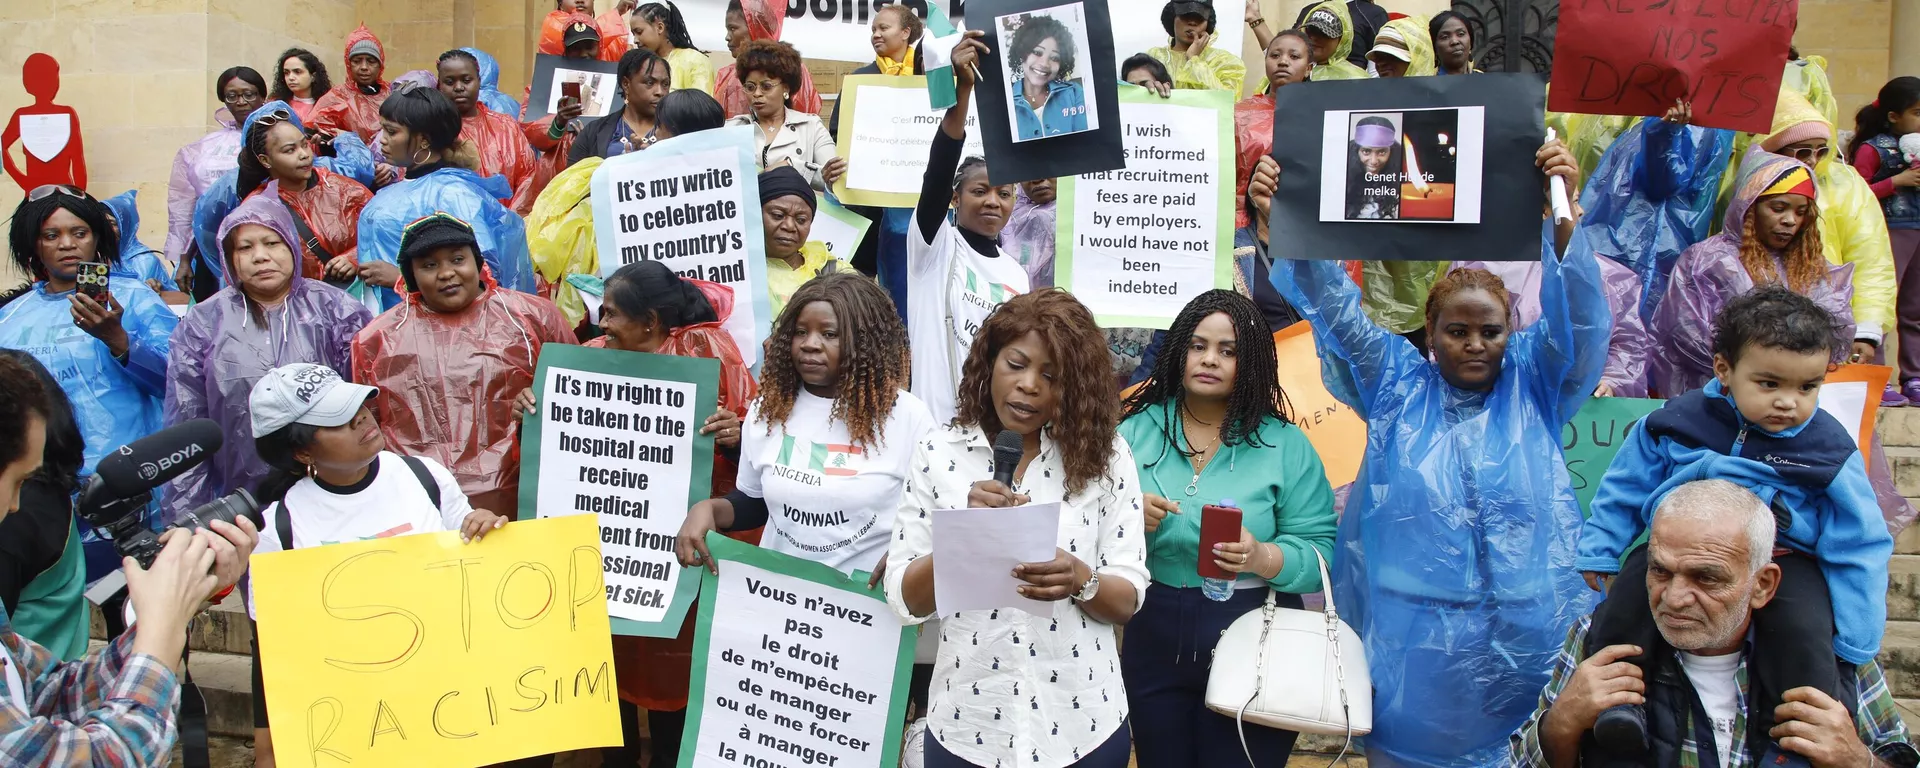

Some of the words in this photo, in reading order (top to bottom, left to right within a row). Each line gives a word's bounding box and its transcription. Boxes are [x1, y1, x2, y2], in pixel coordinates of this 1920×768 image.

[1649, 25, 1719, 61] NOS
[1576, 55, 1768, 118] DROITS
[913, 115, 942, 125] mon
[1126, 123, 1131, 136] I
[1135, 124, 1171, 138] wish
[1134, 145, 1205, 162] informed
[617, 180, 646, 203] It's
[650, 177, 678, 198] my
[682, 168, 733, 193] write
[1117, 169, 1209, 184] recruitment
[1364, 171, 1396, 182] Genet
[1399, 171, 1434, 182] Hude
[1096, 189, 1128, 204] fees
[1132, 193, 1158, 205] are
[1162, 192, 1196, 208] paid
[619, 213, 639, 233] to
[643, 200, 737, 230] celebrate
[1093, 211, 1111, 228] by
[1116, 213, 1201, 230] employers.
[621, 244, 649, 264] my
[653, 229, 743, 260] country's
[1080, 234, 1084, 247] I
[1089, 235, 1137, 249] would
[1142, 236, 1178, 251] have
[1183, 240, 1209, 252] not
[708, 260, 745, 284] and
[1123, 257, 1161, 272] been
[1108, 279, 1177, 295] indebted
[962, 292, 994, 312] NIGER
[555, 374, 581, 396] It's
[586, 380, 612, 402] my
[617, 382, 662, 405] right
[666, 388, 685, 408] to
[551, 402, 572, 423] be
[577, 407, 628, 430] taken
[633, 413, 651, 433] to
[655, 416, 685, 437] the
[158, 443, 203, 471] BOYA
[559, 432, 634, 460] hospital
[639, 445, 674, 464] and
[579, 466, 649, 490] receive
[772, 465, 822, 487] NIGERIA
[574, 494, 649, 519] medical
[783, 504, 849, 527] VONWAIL
[634, 528, 677, 552] from
[800, 543, 819, 553] WOMEN
[819, 538, 851, 553] ASSOCIATION
[851, 534, 858, 542] IN
[857, 514, 877, 538] LEBANON
[603, 556, 671, 581] ssional
[322, 546, 604, 673] STOP
[623, 587, 665, 609] sick.
[745, 577, 797, 605] Vous
[804, 597, 873, 627] n'avez
[784, 618, 823, 639] pas
[761, 634, 781, 653] le
[788, 643, 839, 671] droit
[721, 649, 745, 666] de
[751, 658, 877, 705] m'empêcher
[738, 678, 763, 697] de
[770, 689, 852, 724] manger
[307, 661, 610, 768] RACISIM
[716, 696, 739, 712] ou
[745, 703, 768, 720] de
[773, 713, 803, 732] me
[809, 722, 870, 752] forcer
[718, 741, 737, 762] la
[738, 724, 751, 741] à
[757, 732, 838, 768] manger
